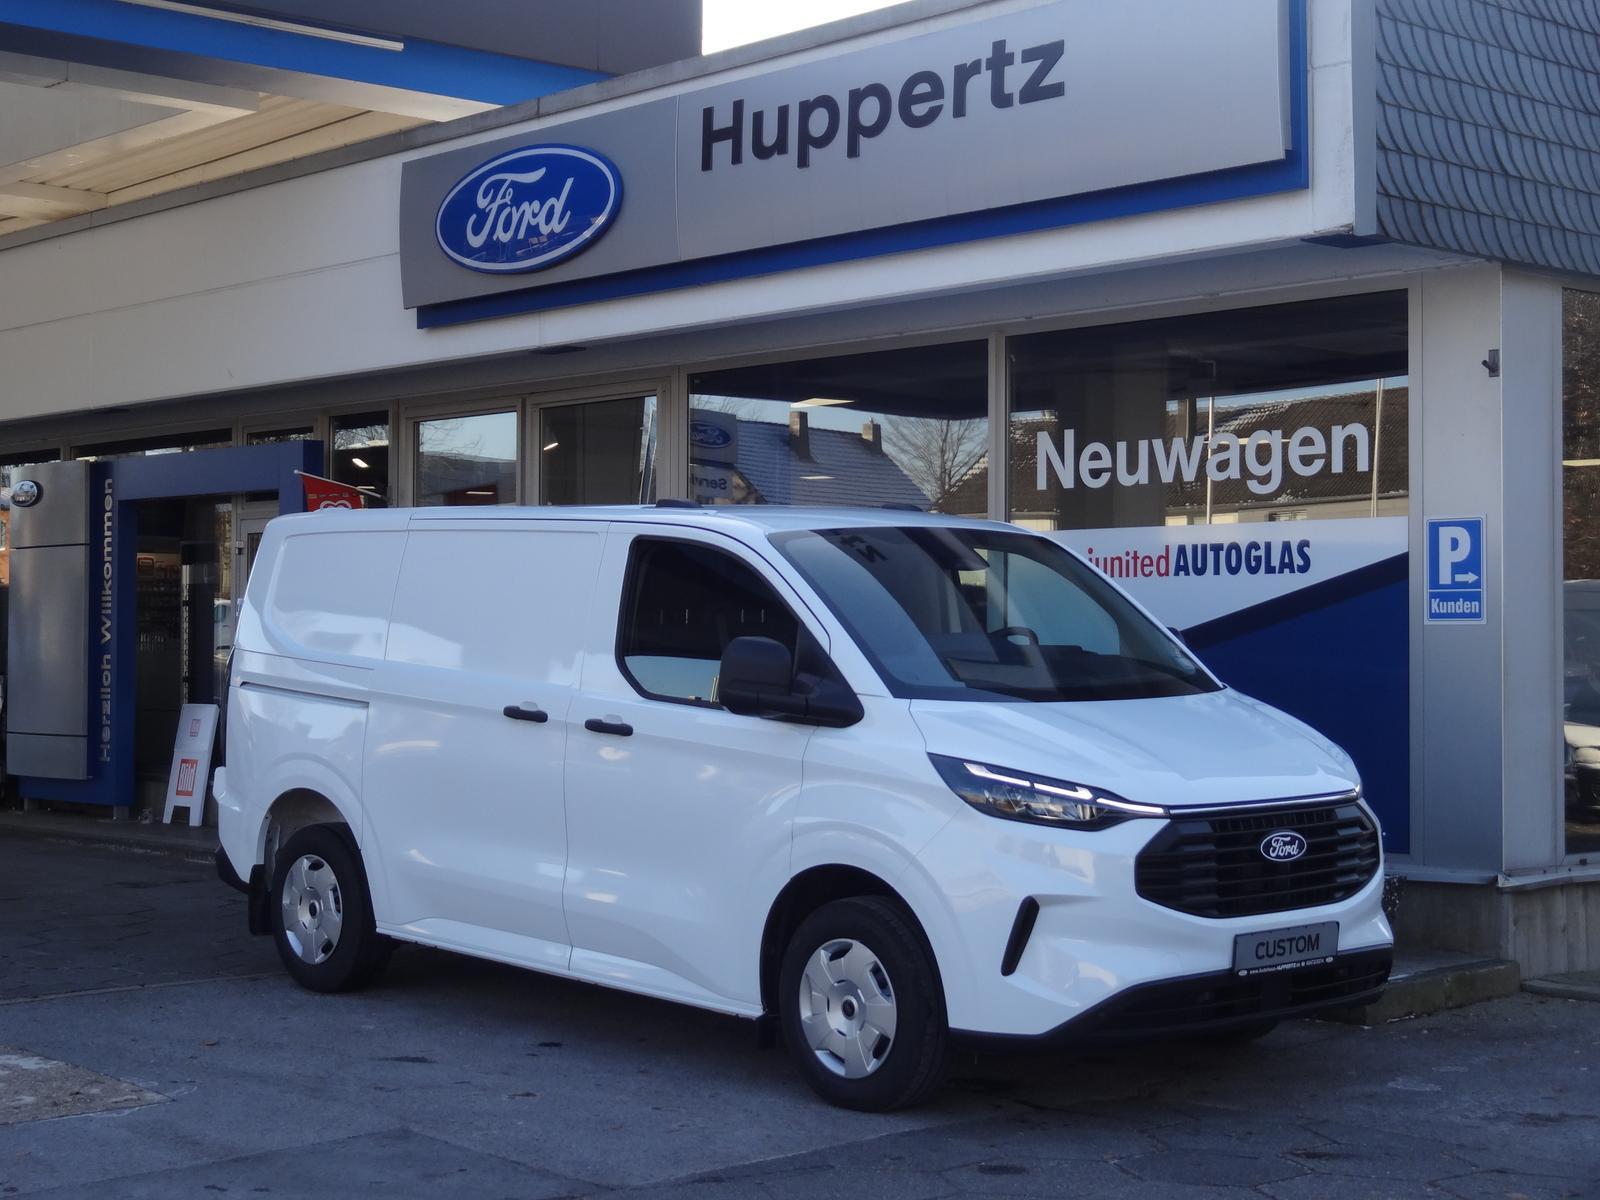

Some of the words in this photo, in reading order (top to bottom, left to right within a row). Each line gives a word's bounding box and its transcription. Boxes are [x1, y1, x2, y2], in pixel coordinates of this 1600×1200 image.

[701, 39, 1065, 172] Huppertz
[466, 167, 575, 248] Ford
[1036, 422, 1369, 495] Neuwagen
[100, 478, 113, 644] Willkommen
[1173, 539, 1312, 577] AUTOGLAS
[1438, 526, 1471, 585] P
[1431, 598, 1480, 613] Kunden
[1269, 836, 1299, 857] Ford
[1255, 933, 1320, 960] CUSTOM
